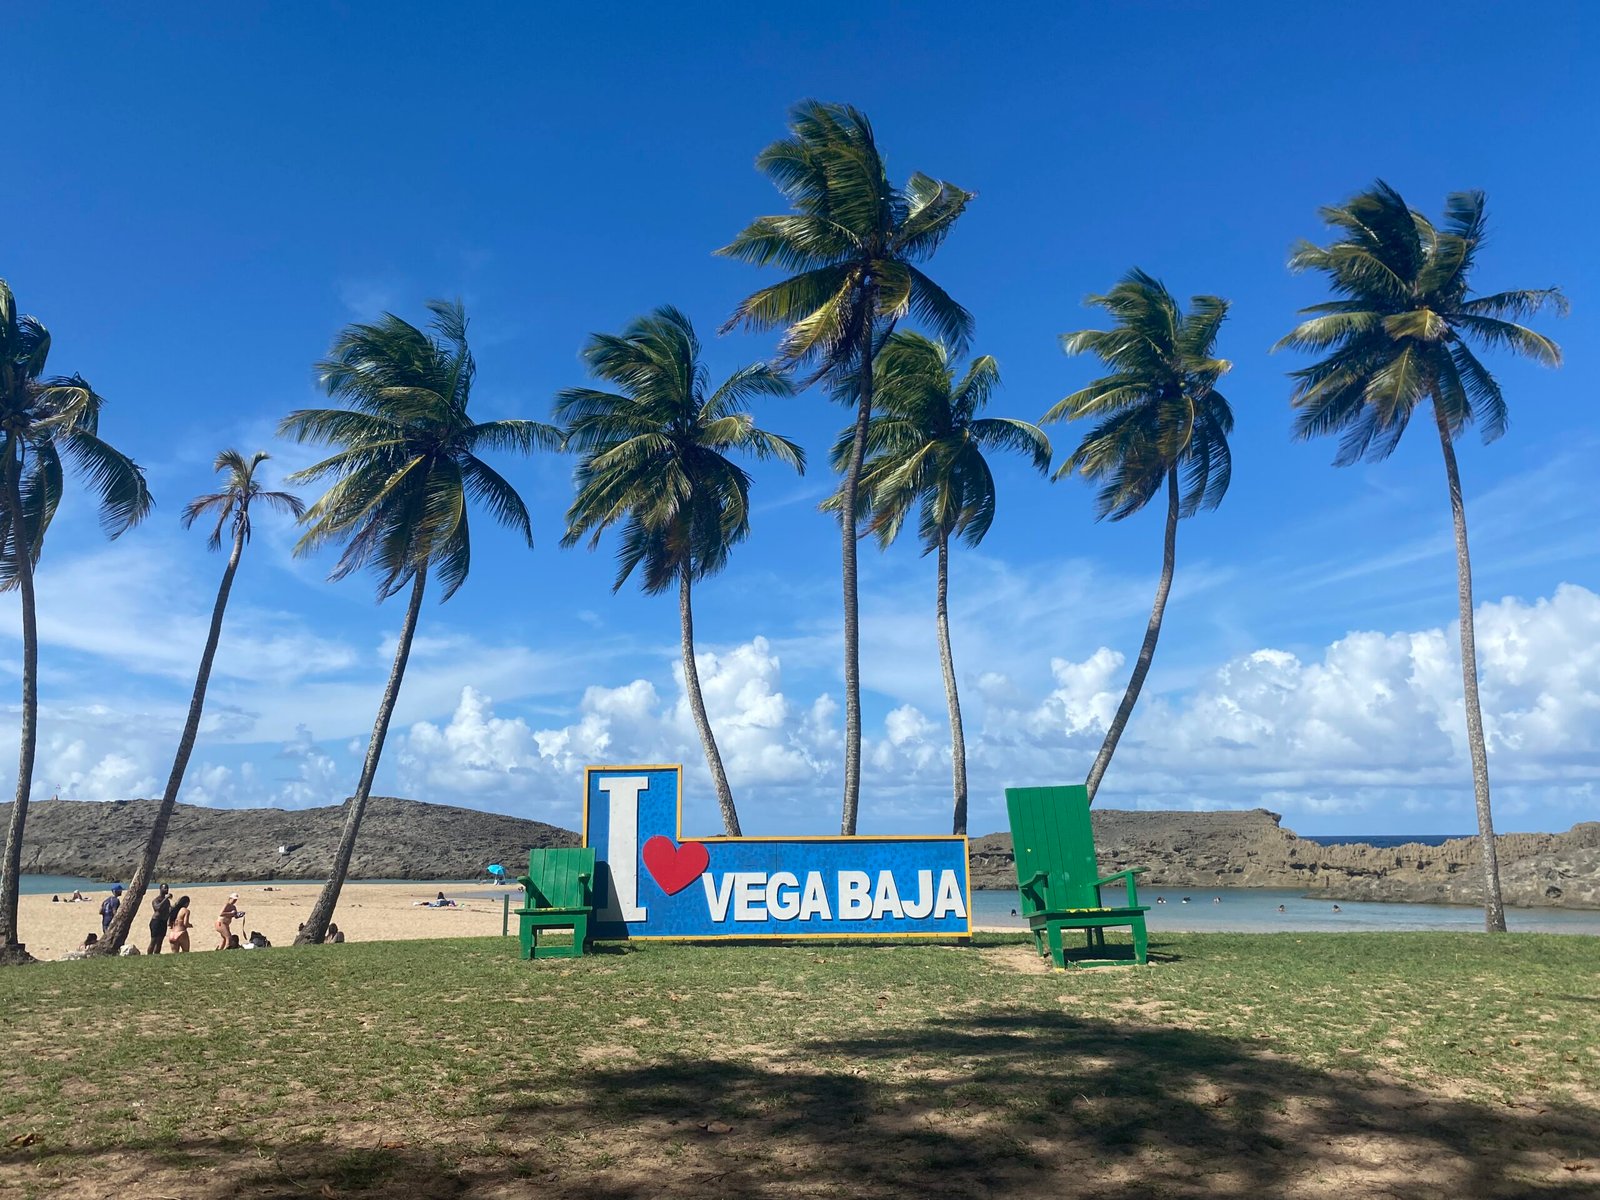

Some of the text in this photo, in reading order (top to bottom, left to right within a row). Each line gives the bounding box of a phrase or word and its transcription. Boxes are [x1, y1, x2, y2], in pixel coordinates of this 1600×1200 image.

[597, 776, 649, 922] I
[702, 869, 968, 922] VEGA BAJA
